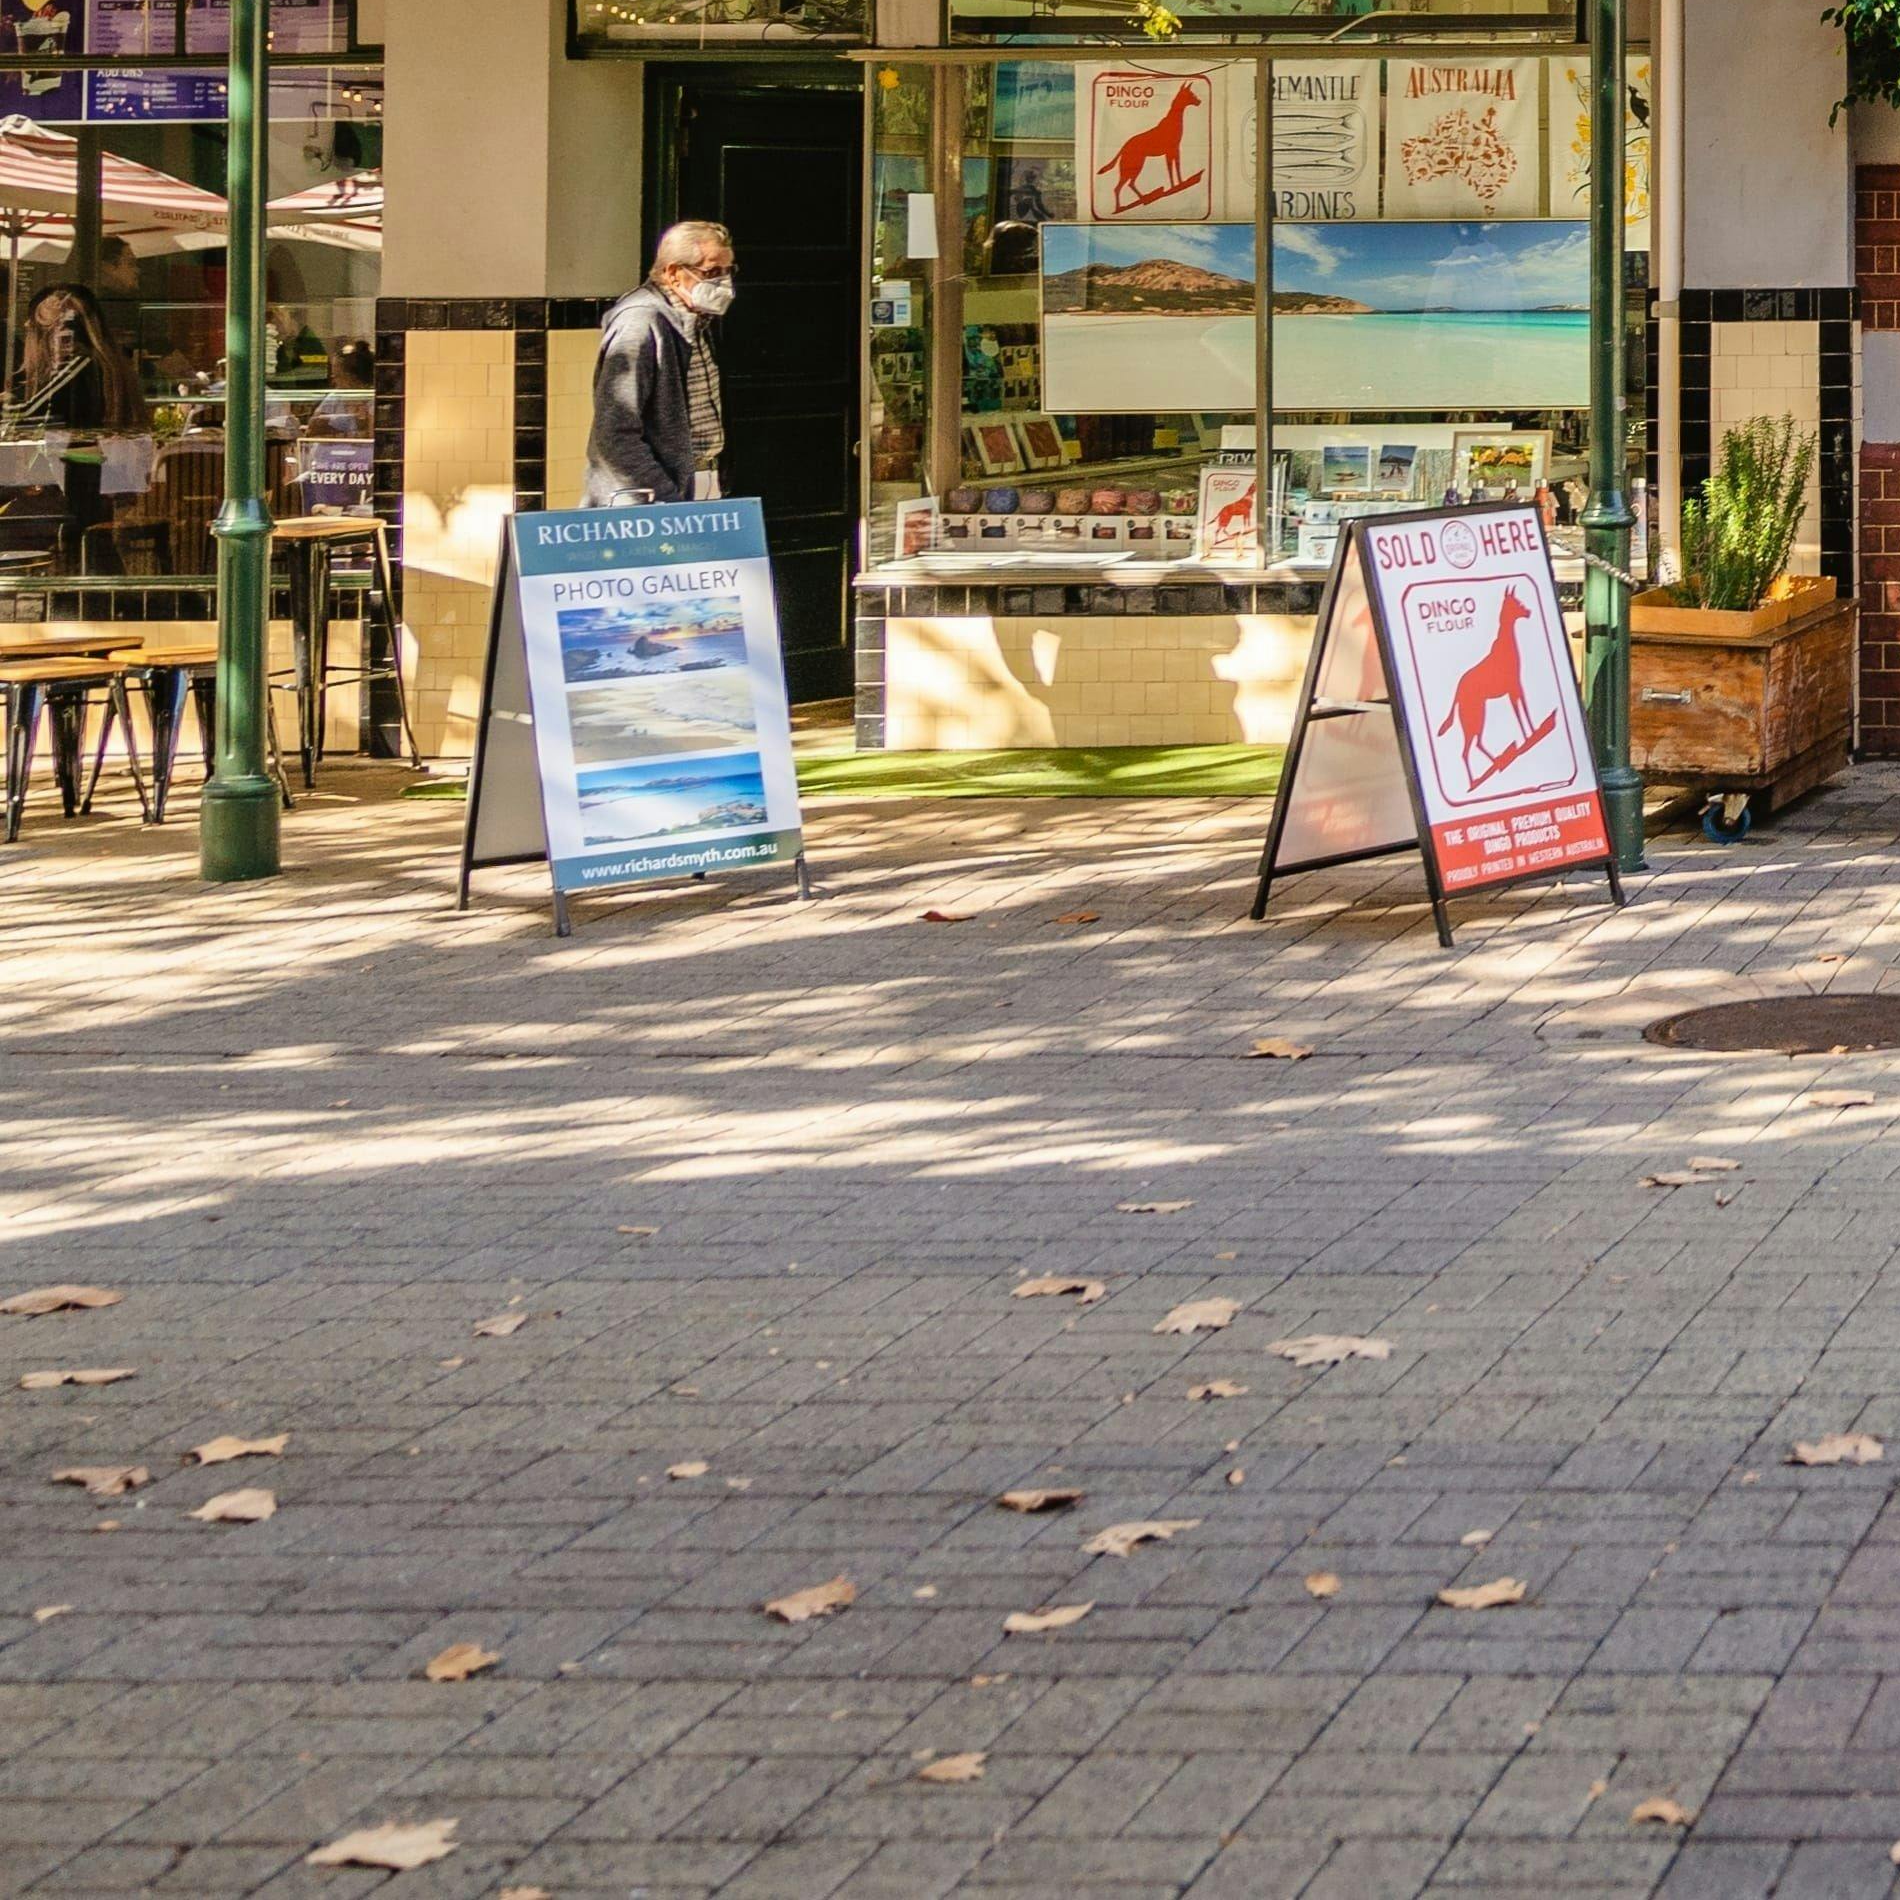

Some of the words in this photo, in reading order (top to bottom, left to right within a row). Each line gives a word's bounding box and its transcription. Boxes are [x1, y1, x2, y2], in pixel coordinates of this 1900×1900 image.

[1106, 85, 1155, 99] DINGO
[1404, 66, 1517, 101] AUSTRALIA
[1110, 99, 1150, 109] FLOUR
[310, 472, 346, 485] EVERY
[348, 472, 375, 485] DAY
[1213, 479, 1241, 488] DINGO
[537, 517, 656, 546] RICHARD
[660, 511, 743, 537] SMYTH
[1376, 531, 1437, 571] SOLD
[1479, 518, 1539, 557] HERE
[553, 577, 635, 602] PHOTO
[642, 568, 740, 595] GALLERY
[1418, 597, 1477, 620] DINGO
[1426, 616, 1475, 634] FLOUR
[1443, 828, 1465, 847] THE
[1466, 820, 1509, 843] ORIGINAL
[1511, 810, 1553, 832] PREMIUM
[1554, 801, 1592, 822] QUALITY
[1514, 825, 1561, 848] PRODUCTS
[581, 841, 779, 880] www.richardsmyth.com.au
